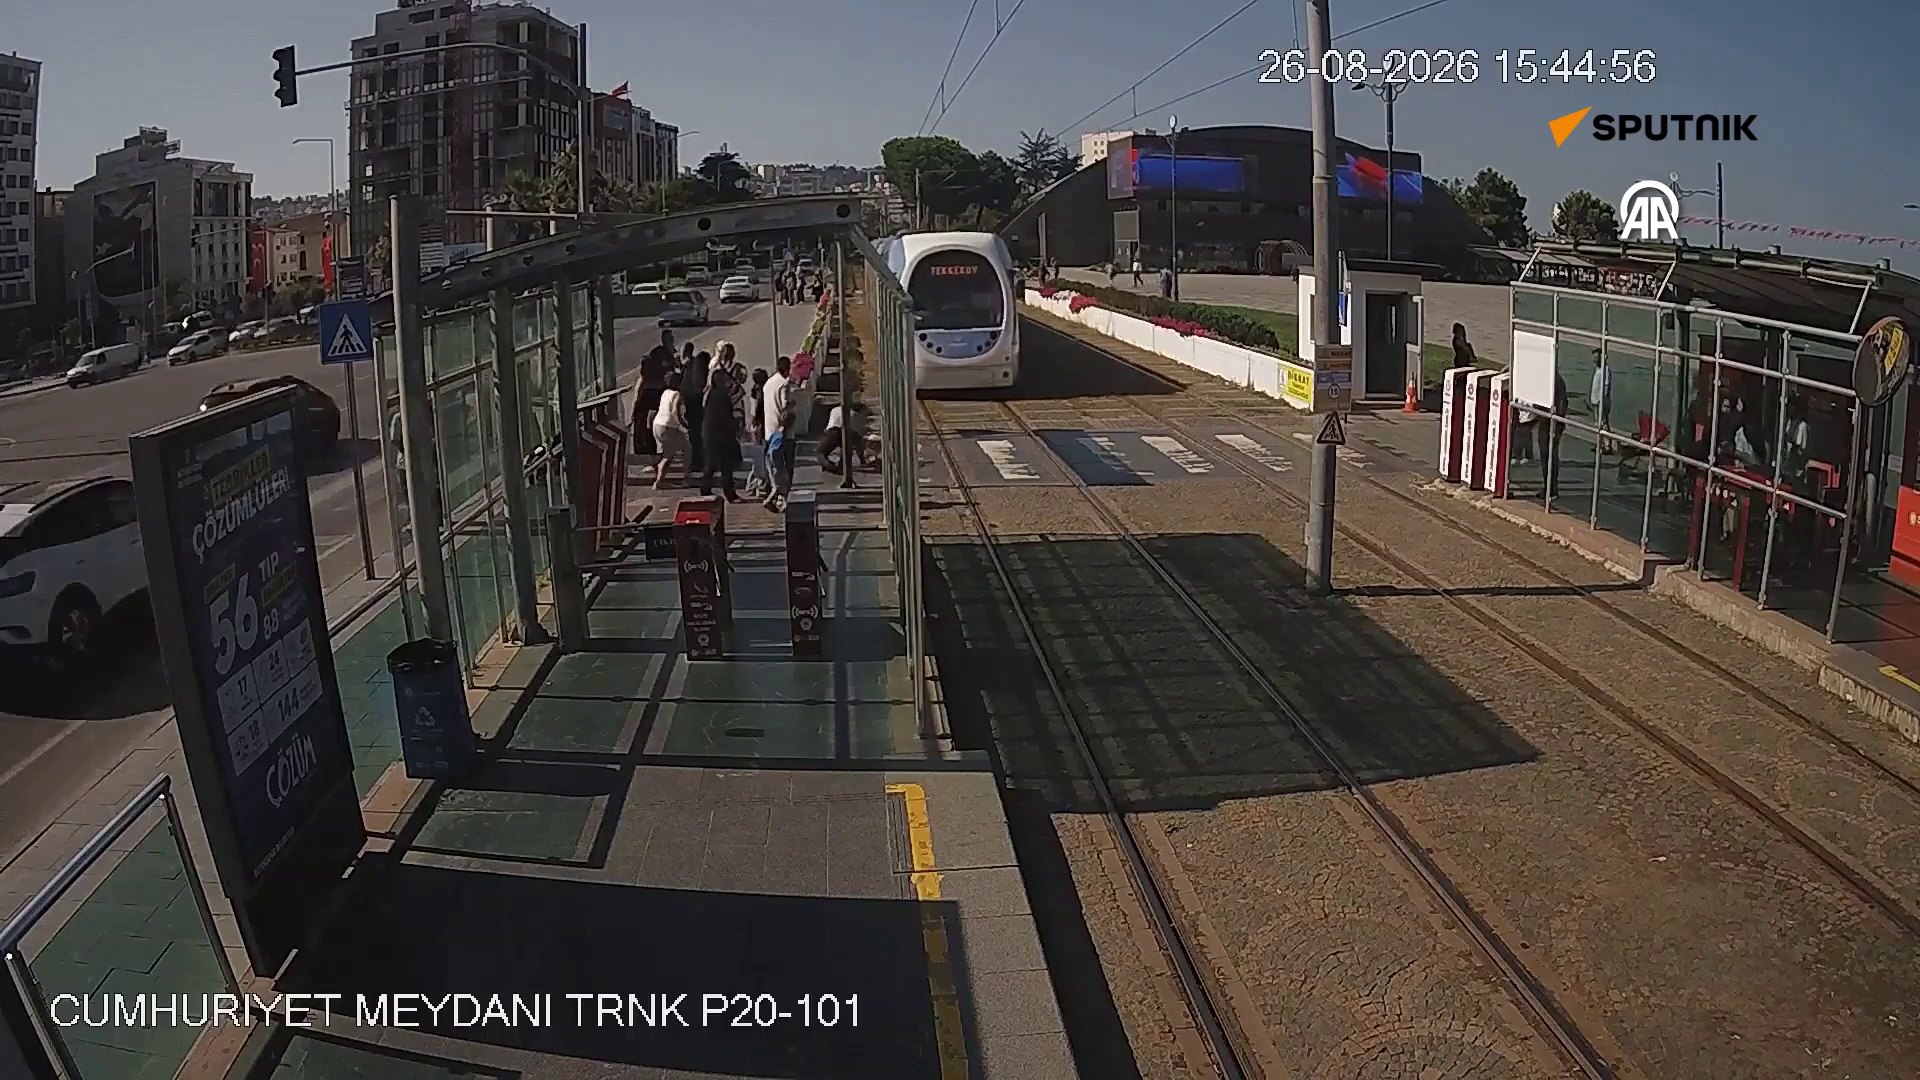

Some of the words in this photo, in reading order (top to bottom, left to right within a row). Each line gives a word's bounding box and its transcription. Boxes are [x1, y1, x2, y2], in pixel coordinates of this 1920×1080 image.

[258, 551, 279, 582] TIP
[209, 571, 259, 675] 56
[263, 607, 279, 640] 88
[278, 687, 299, 722] 144
